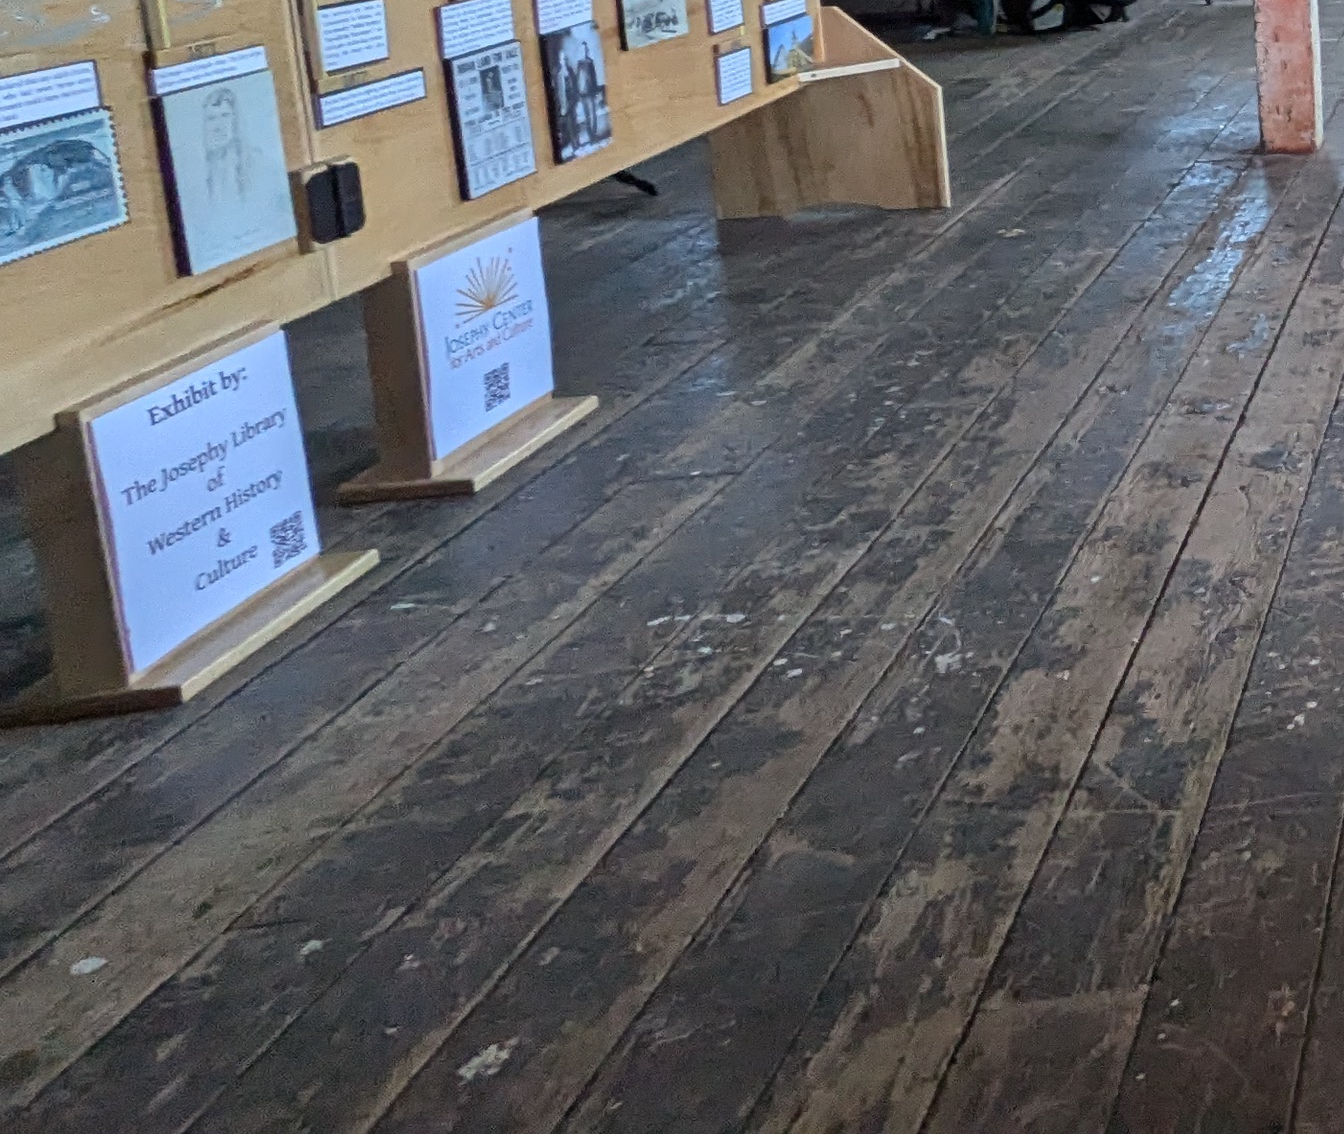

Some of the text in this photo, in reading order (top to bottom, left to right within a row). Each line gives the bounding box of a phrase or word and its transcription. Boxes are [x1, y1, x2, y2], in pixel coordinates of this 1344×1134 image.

[146, 367, 249, 427] Exhibit by:
[120, 407, 288, 507] The Josephy Library
[206, 465, 226, 492] of
[146, 469, 283, 556] Western History
[216, 527, 232, 548] &
[195, 544, 258, 592] Culture
